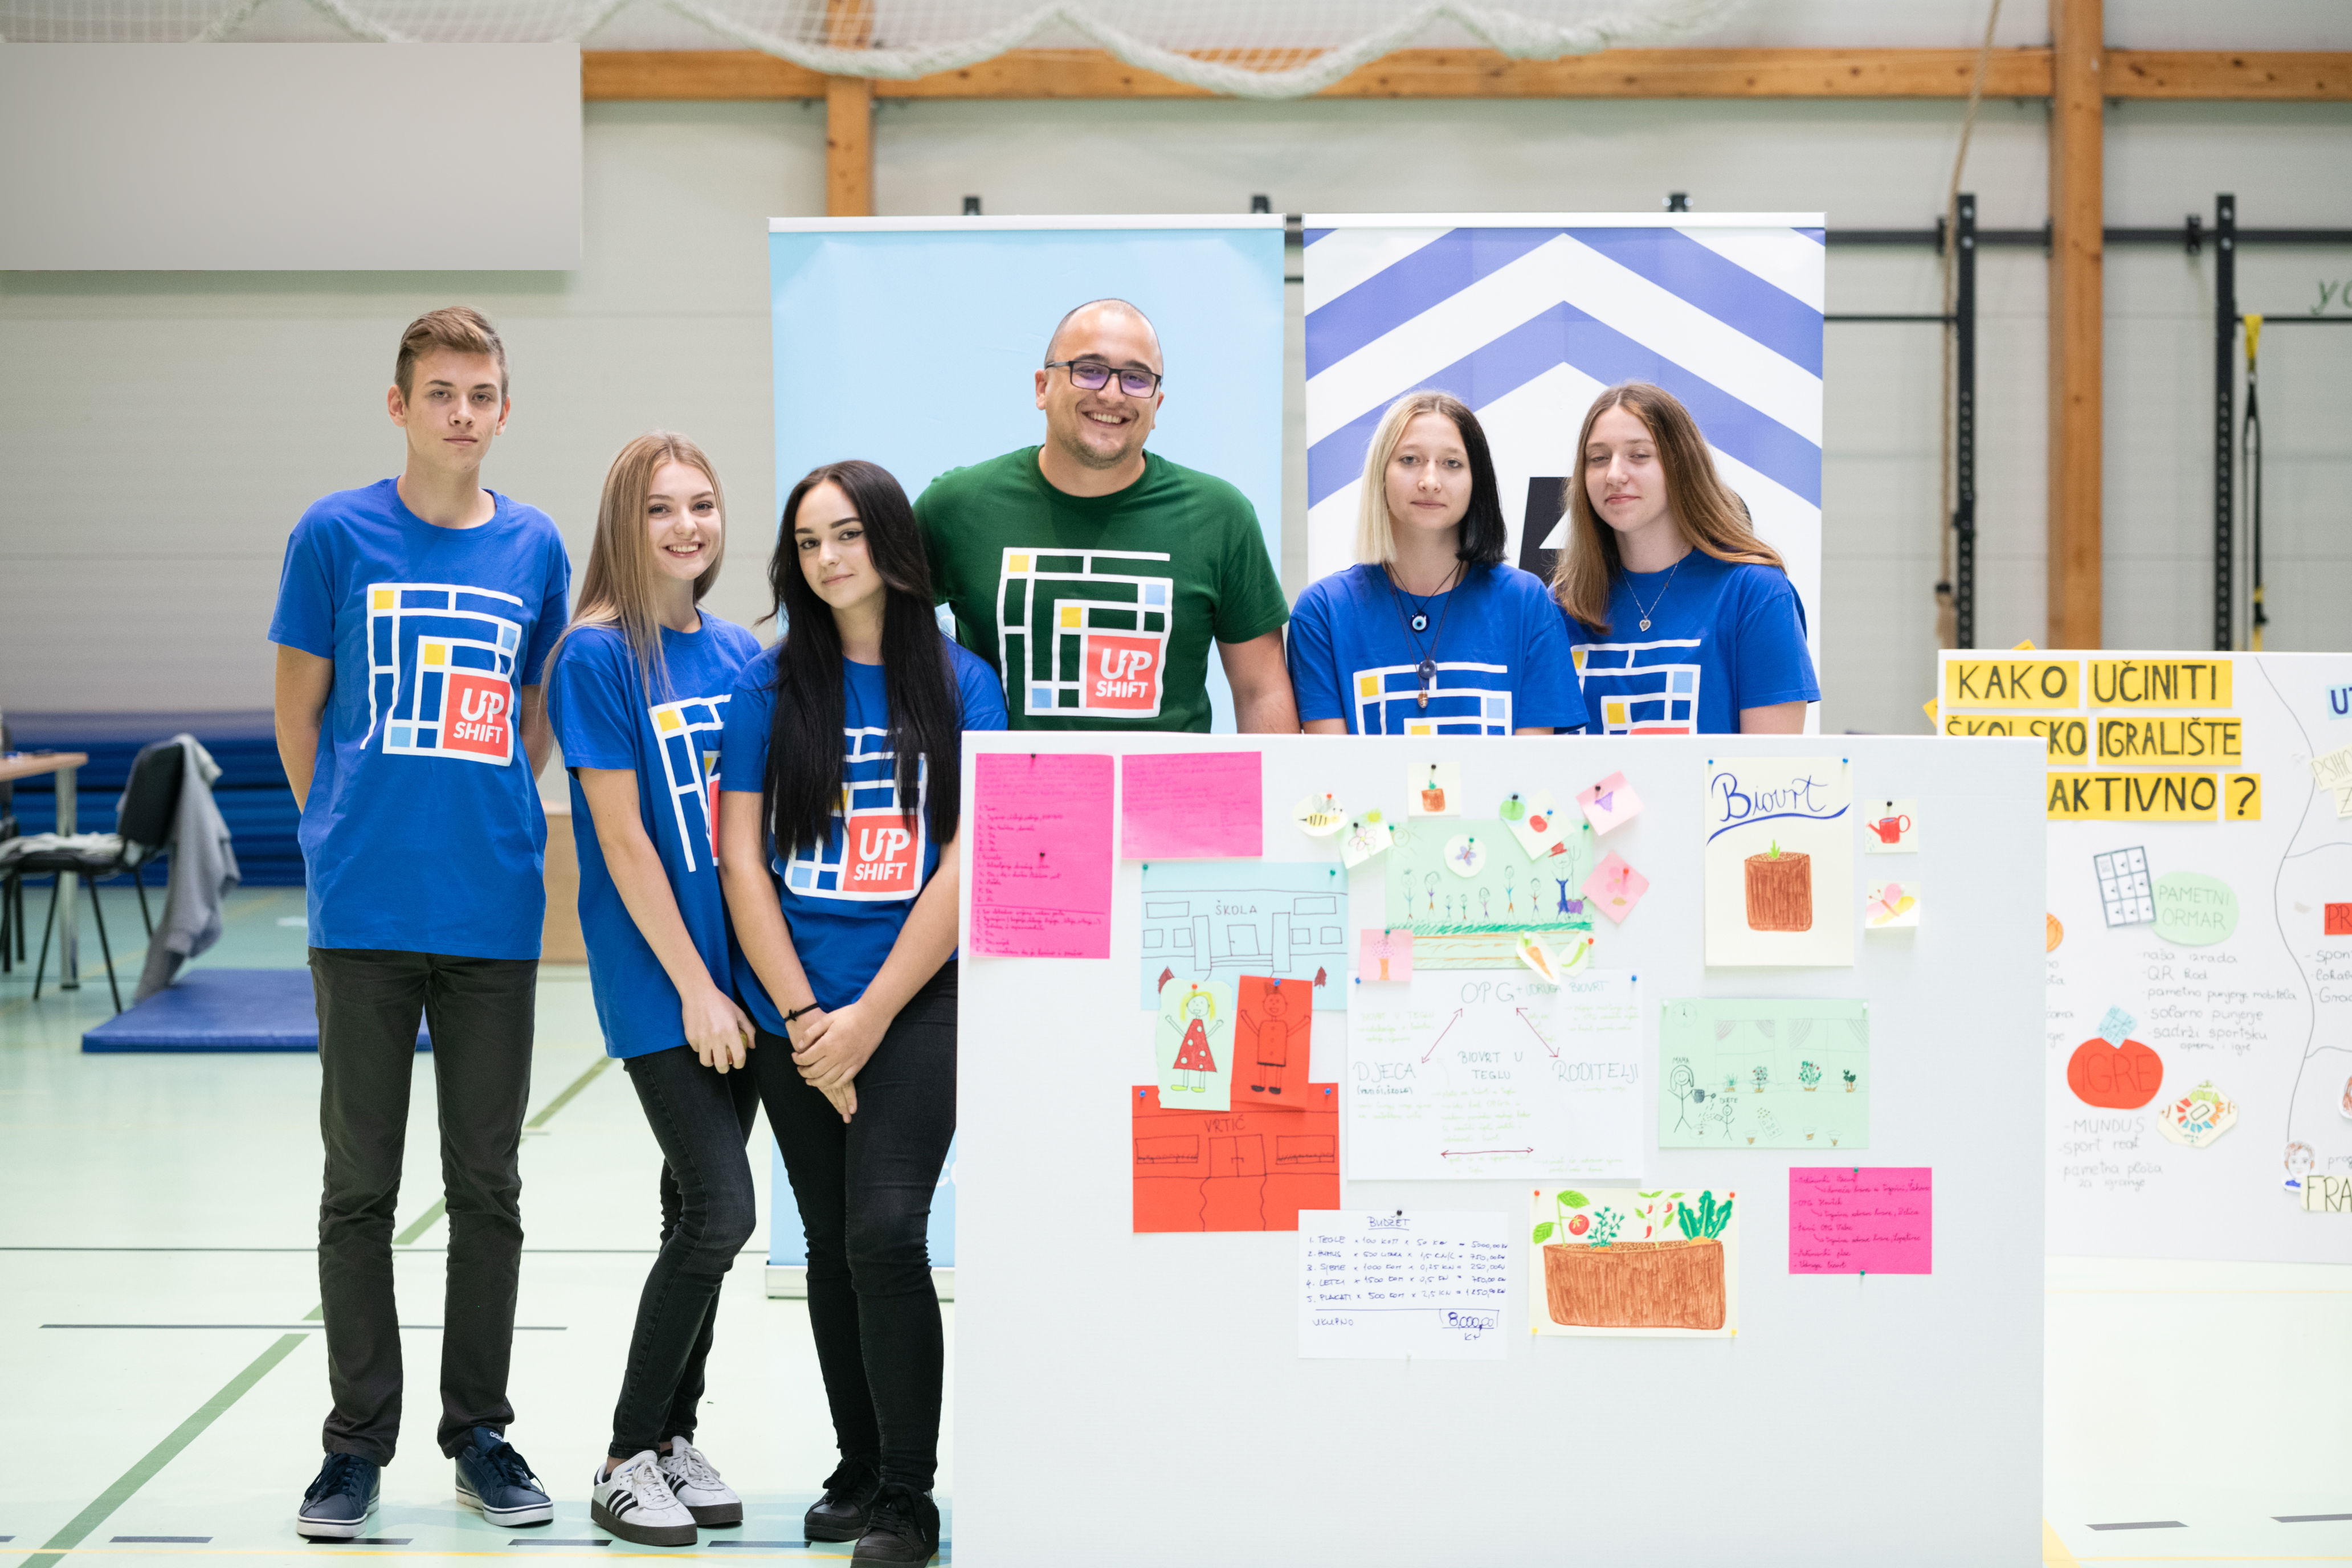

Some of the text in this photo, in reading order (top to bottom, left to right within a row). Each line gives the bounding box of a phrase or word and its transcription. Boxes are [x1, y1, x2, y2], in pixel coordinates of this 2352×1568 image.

[1100, 648, 1153, 680] UP
[1095, 680, 1149, 698] SHIFT
[1958, 661, 2216, 703] KAKO UČINITI
[460, 688, 505, 723] UP
[453, 721, 503, 744] SHIFT
[2098, 717, 2241, 758] IGRALIŠTE
[1711, 772, 1828, 822] Biovrt
[2047, 777, 2257, 816] AKTIVNO ?
[859, 828, 910, 862] UP
[853, 862, 908, 881] SHIFT
[2159, 884, 2230, 906] PAMETNI
[1215, 899, 1258, 916] ŠKOLA
[2162, 907, 2226, 930] ORMAR
[2143, 948, 2238, 964] naša izrada
[2147, 965, 2175, 981] QR
[1460, 981, 1515, 1004] OPG
[1525, 983, 1562, 997] UDRUGA
[1568, 979, 1610, 993] BIOVRT
[2147, 986, 2202, 1000] pametno
[2253, 989, 2297, 1001] mobitela
[2150, 1004, 2264, 1026] solarno punjenje
[2153, 1024, 2268, 1041] sadrži sportsku
[1457, 1051, 1524, 1064] BIOVRT U
[2180, 1042, 2215, 1051] opremu
[2231, 1043, 2251, 1056] igre
[1353, 1060, 1416, 1083] DJECA
[1471, 1069, 1511, 1080] TEGLU
[1551, 1060, 1639, 1084] RODITELJI
[2082, 1053, 2156, 1093] IGRE
[1203, 1114, 1246, 1134] VRTIĆ
[2073, 1116, 2145, 1134] MUNDUS
[2063, 1137, 2102, 1158] sport
[2063, 1159, 2163, 1182] pametna ploča
[2104, 1179, 2146, 1193] igranje
[1366, 1215, 1411, 1227] BUDŽET
[1318, 1235, 1346, 1244] TEGLE
[1420, 1252, 1432, 1261] 1,5
[1320, 1263, 1346, 1276] SJEME
[1420, 1264, 1439, 1272] 0,25
[1306, 1279, 1315, 1289] 4.
[1419, 1276, 1435, 1285] 0,5
[1421, 1290, 1436, 1299] 2,5
[1312, 1317, 1354, 1326] UKUPNO
